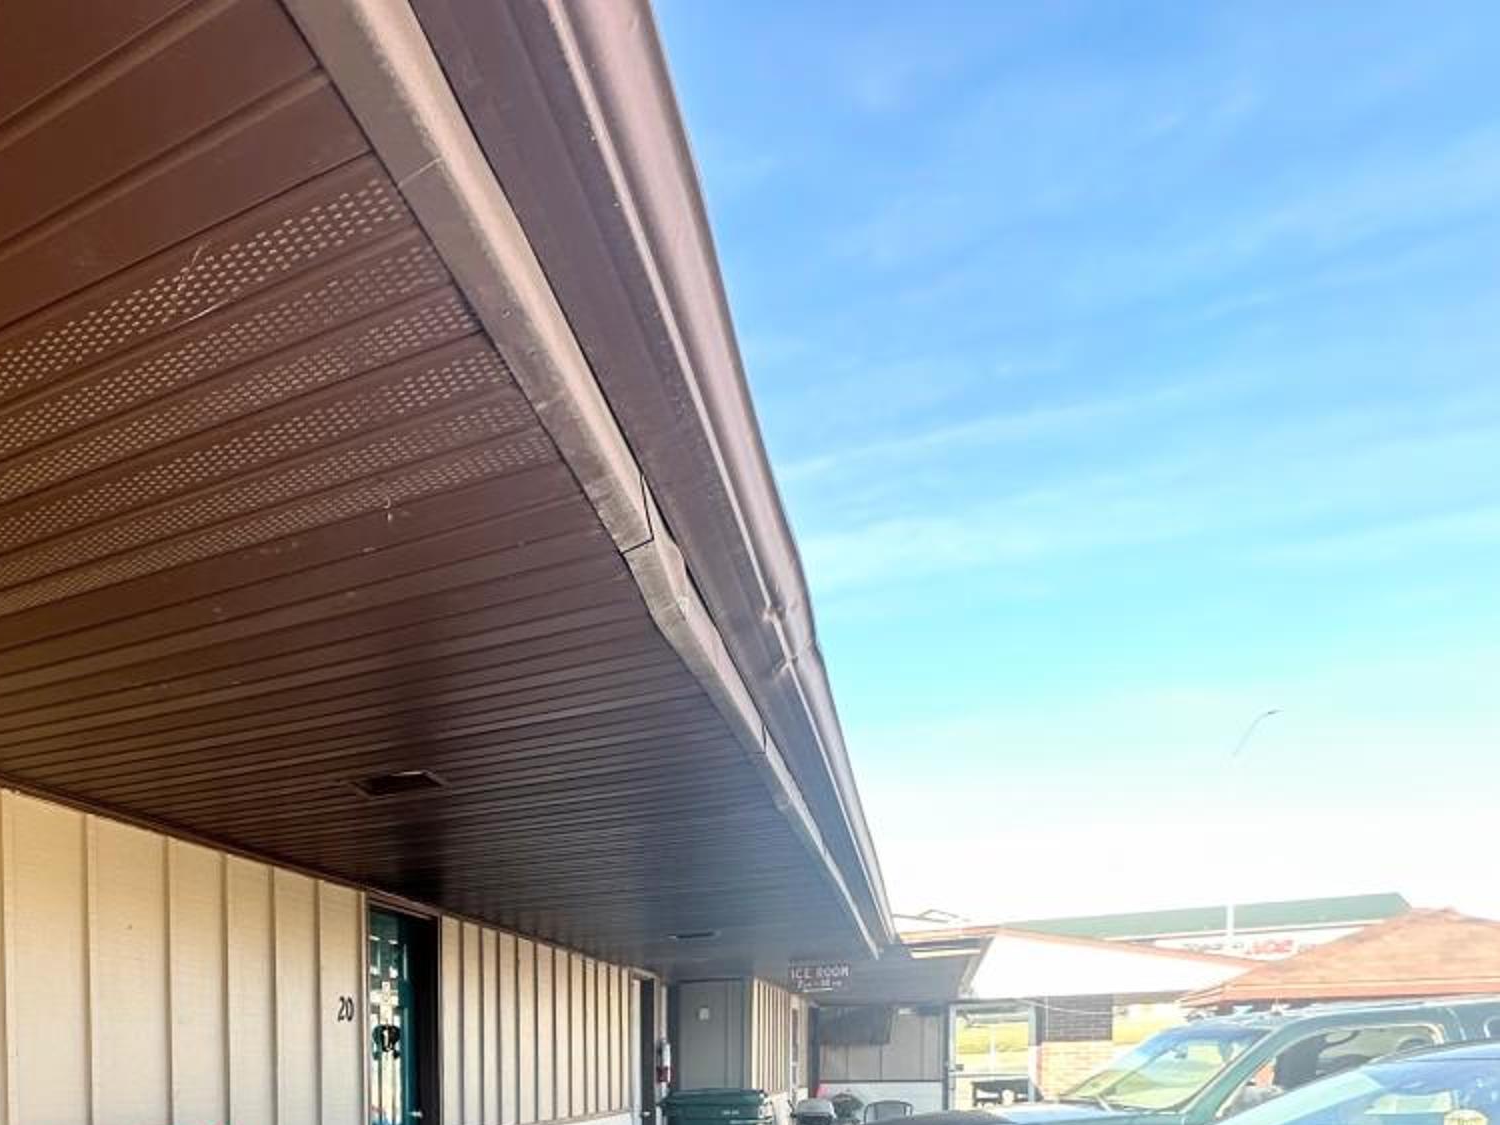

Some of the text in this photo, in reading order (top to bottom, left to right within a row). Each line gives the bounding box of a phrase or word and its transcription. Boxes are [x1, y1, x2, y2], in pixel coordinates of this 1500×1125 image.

[791, 965, 850, 979] ICE ROOM
[337, 995, 355, 1022] 20
